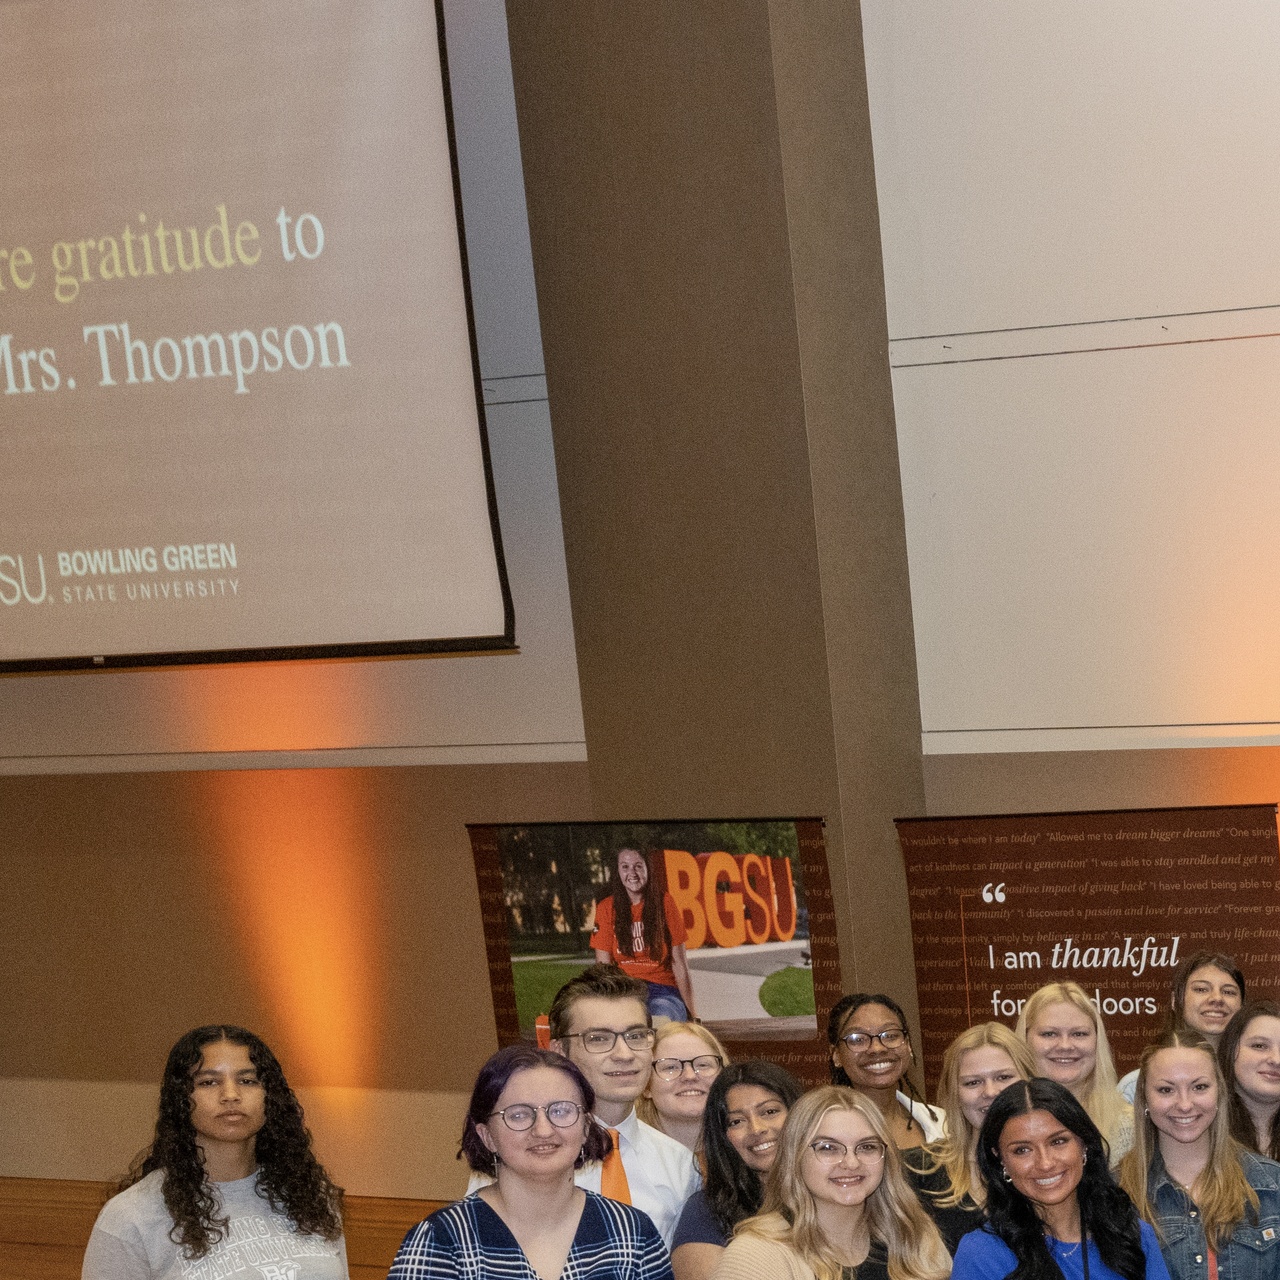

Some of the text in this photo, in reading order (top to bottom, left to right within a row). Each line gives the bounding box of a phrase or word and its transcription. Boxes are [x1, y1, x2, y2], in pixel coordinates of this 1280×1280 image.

[52, 205, 263, 303] gratitude
[276, 206, 325, 262] to
[83, 319, 352, 394] Thompson
[57, 543, 238, 577] BOWLING GREEN
[62, 577, 239, 604] STATE UNIVERSITY
[1103, 832, 1113, 840] to
[1150, 829, 1181, 842] bigger
[989, 861, 1023, 873] impact
[1121, 857, 1139, 867] able
[1142, 859, 1152, 867] to
[1154, 857, 1175, 869] stay
[1177, 854, 1219, 865] enrolled
[1221, 854, 1241, 865] and
[1243, 856, 1258, 867] get
[1260, 856, 1276, 866] my
[664, 849, 798, 950] BGSU
[1041, 884, 1077, 895] impact
[1090, 882, 1120, 896] giving
[1159, 882, 1181, 891] have
[1183, 880, 1208, 890] loved
[1211, 881, 1237, 892] being
[1239, 879, 1259, 889] able
[1026, 908, 1074, 917] discovered
[1085, 906, 1122, 921] passion
[1124, 906, 1143, 916] and
[1145, 906, 1165, 916] love
[1165, 905, 1182, 918] for
[992, 933, 1020, 944] simply
[1023, 933, 1034, 944] by
[1082, 932, 1091, 941] in
[1190, 929, 1207, 939] and
[1210, 930, 1231, 941] truly
[988, 944, 995, 970] I
[1004, 951, 1041, 970] am
[1050, 936, 1180, 978] thankful
[990, 989, 1026, 1016] for
